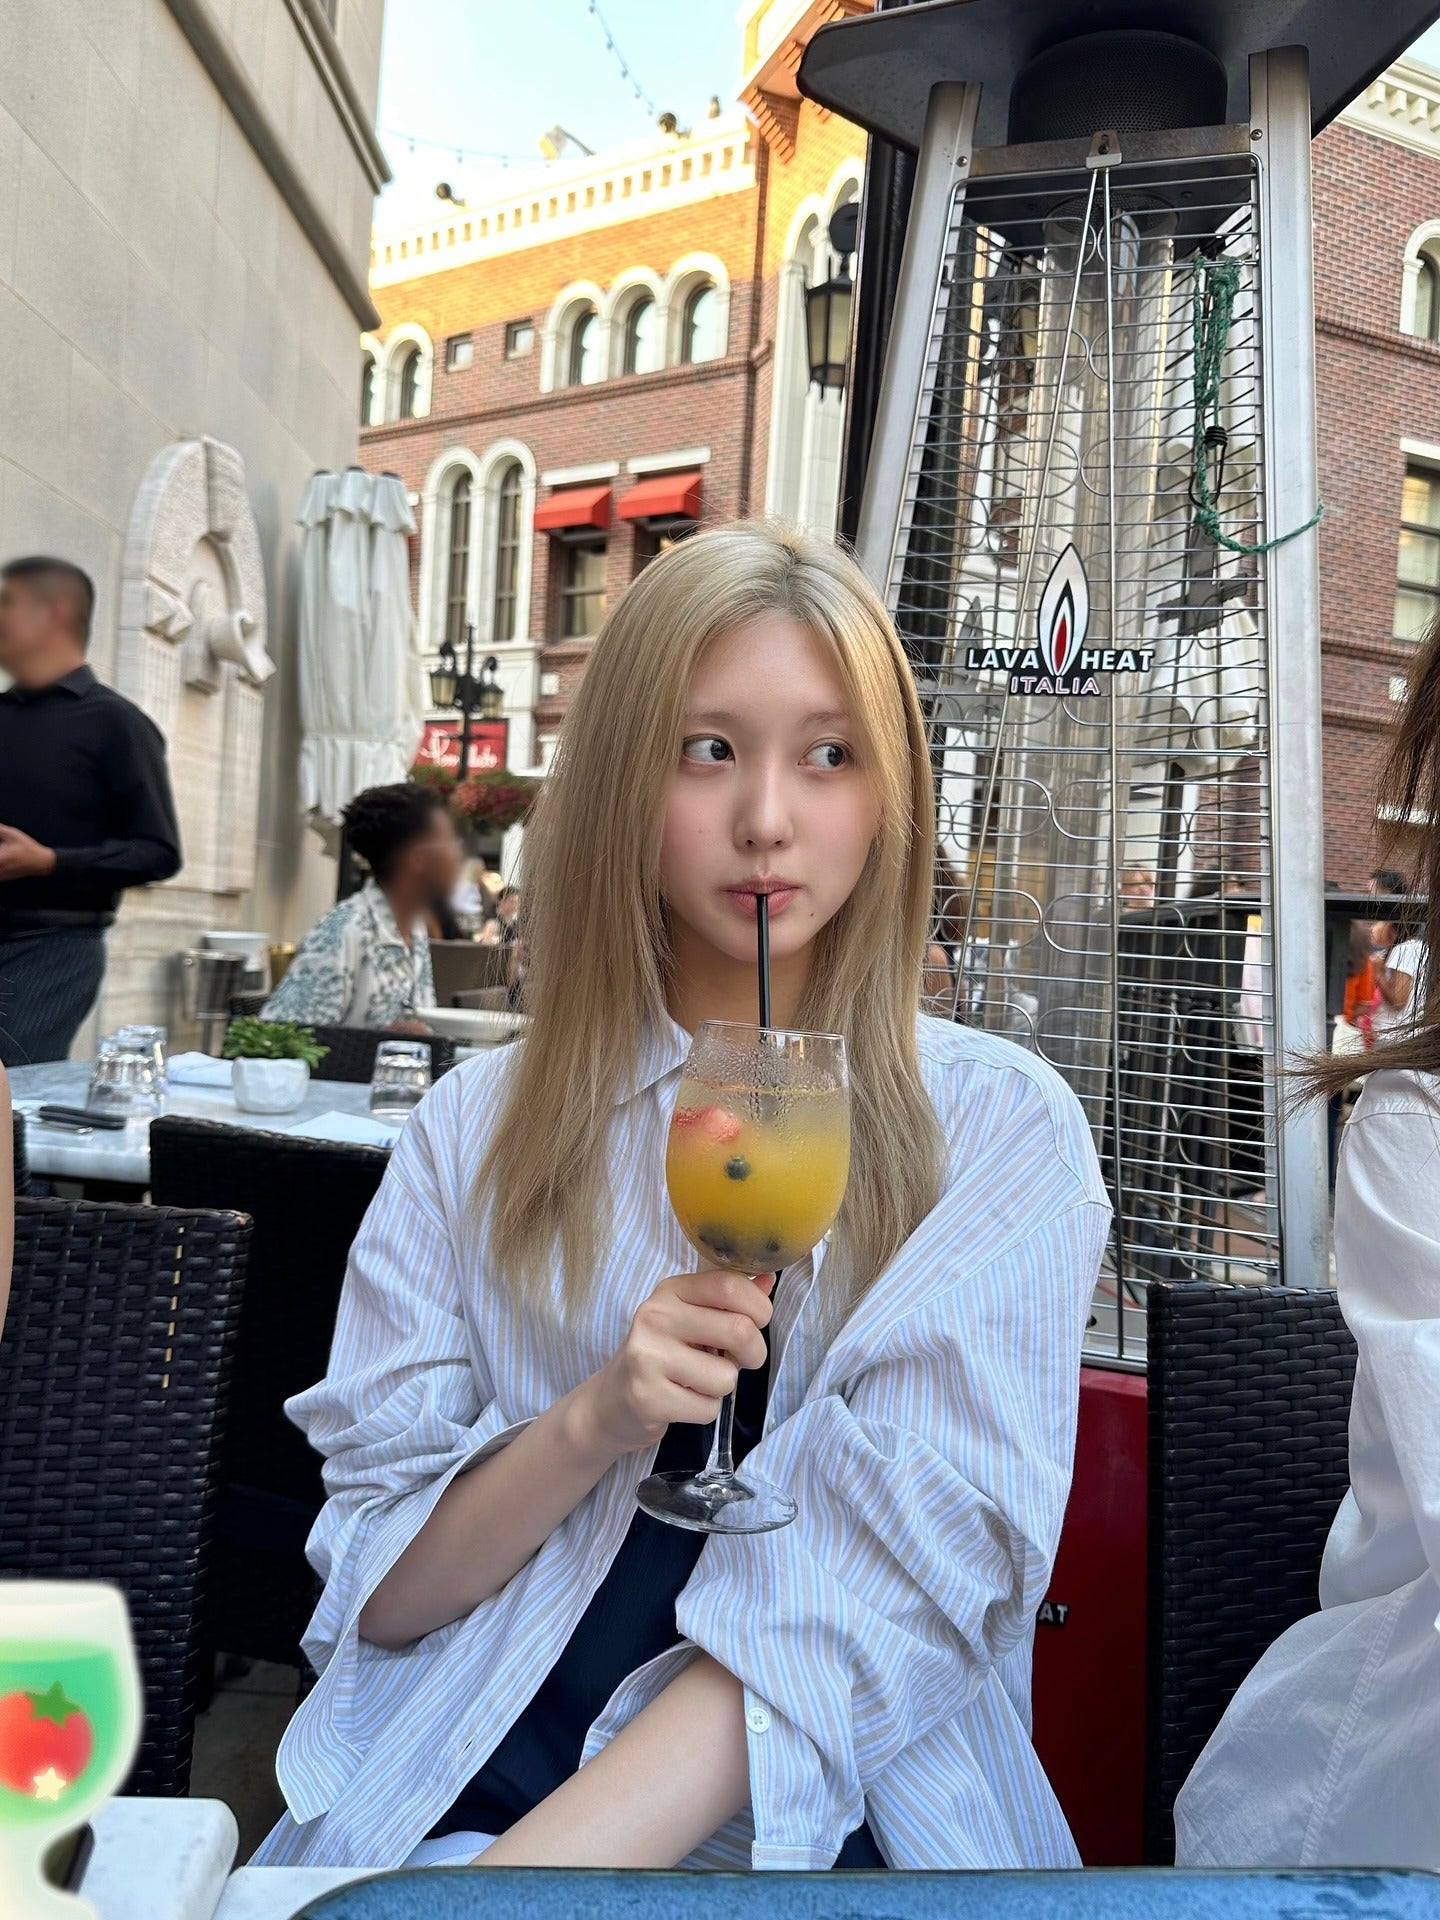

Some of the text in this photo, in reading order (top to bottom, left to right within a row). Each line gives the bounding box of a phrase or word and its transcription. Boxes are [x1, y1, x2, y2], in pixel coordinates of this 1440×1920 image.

[967, 648, 1154, 671] LAVA HEAT
[1010, 676, 1101, 695] ITALIA
[1039, 1602, 1068, 1624] AT
